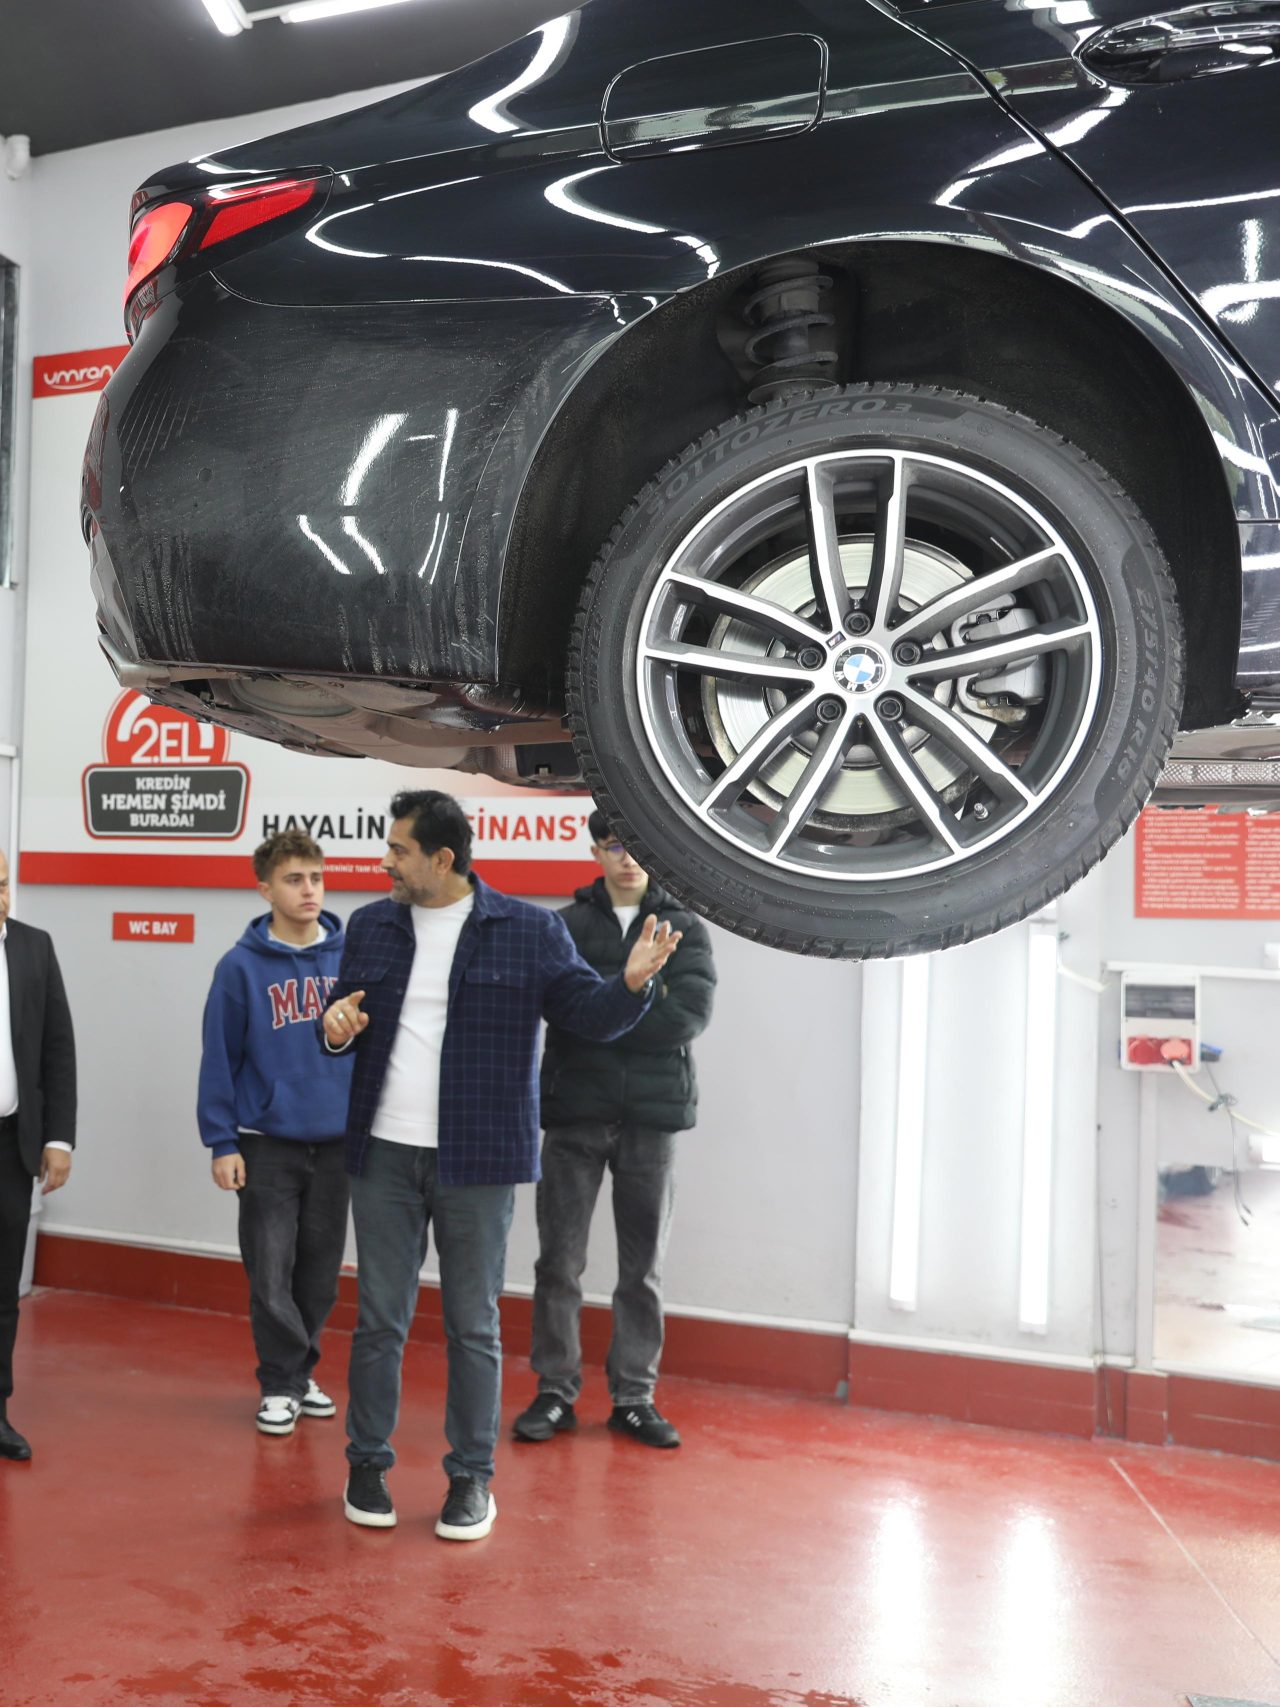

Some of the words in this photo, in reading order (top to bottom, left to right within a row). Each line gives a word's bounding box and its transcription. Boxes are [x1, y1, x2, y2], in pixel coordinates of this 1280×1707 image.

[43, 364, 114, 385] umran
[646, 398, 887, 515] SOTTOZERO
[131, 717, 211, 763] 2.EL
[135, 773, 191, 790] KREDİN
[101, 793, 167, 810] HEMEN
[171, 789, 227, 814] ŞİMDİ
[129, 813, 195, 827] BURADA!
[129, 920, 150, 935] WC
[152, 921, 178, 936] BAY
